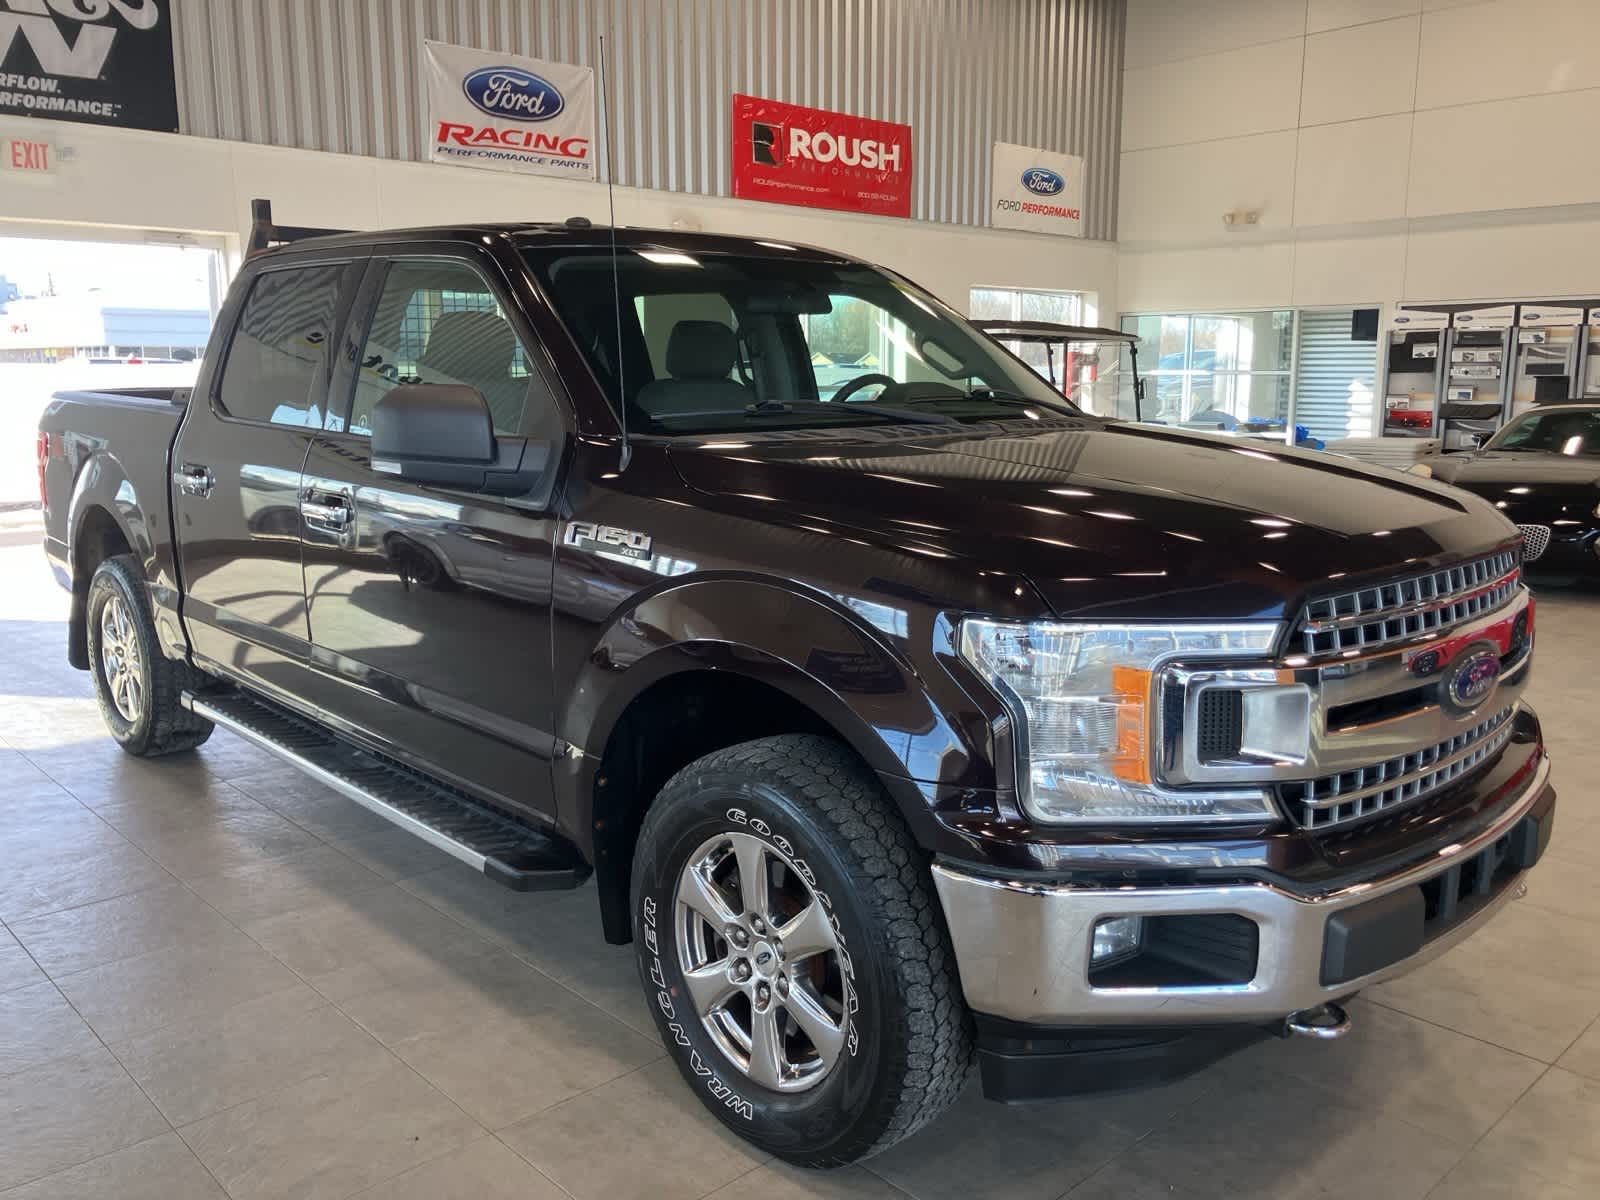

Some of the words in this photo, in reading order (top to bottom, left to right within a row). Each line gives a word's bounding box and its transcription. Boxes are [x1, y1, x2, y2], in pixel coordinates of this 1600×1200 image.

[483, 74, 545, 114] Ford
[11, 140, 49, 170] EXIT
[437, 121, 588, 159] RACING
[789, 127, 900, 172] ROUSH
[437, 146, 546, 165] PERFORMANCE
[550, 159, 590, 170] PARTS
[1029, 171, 1056, 192] Ford
[997, 199, 1020, 211] FORD
[1021, 201, 1080, 220] PERFORMANCE
[621, 548, 641, 557] XLT
[643, 896, 753, 1121] WRANGLER
